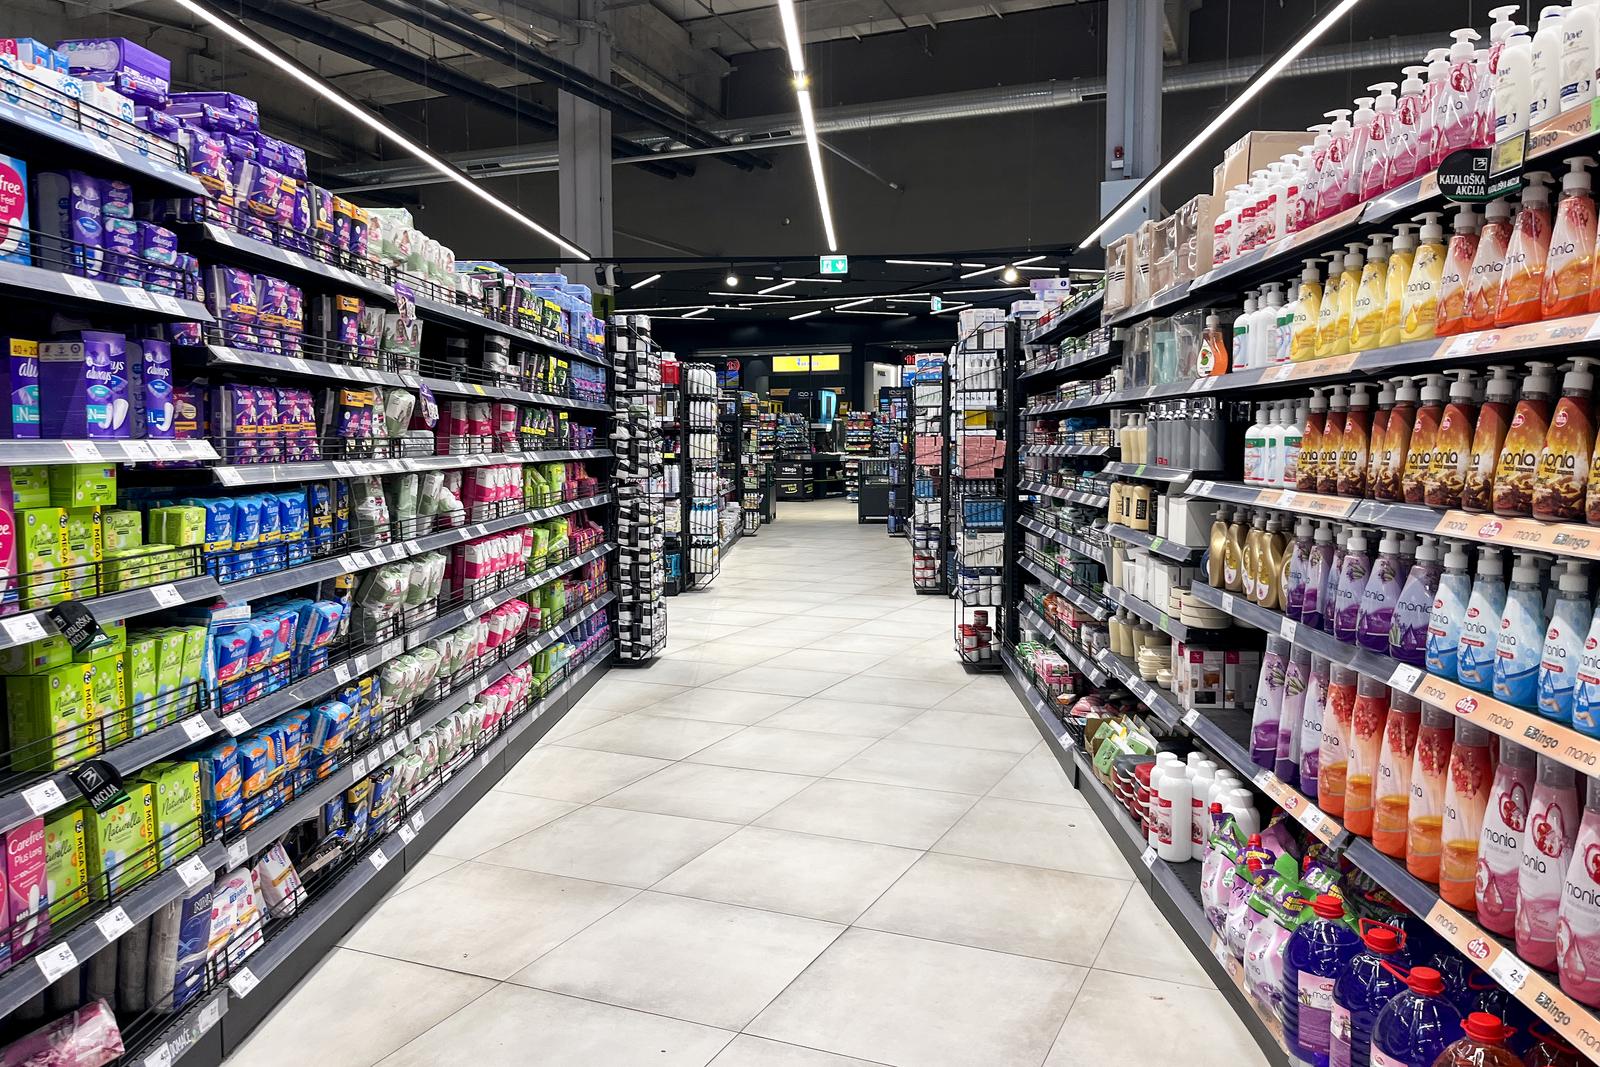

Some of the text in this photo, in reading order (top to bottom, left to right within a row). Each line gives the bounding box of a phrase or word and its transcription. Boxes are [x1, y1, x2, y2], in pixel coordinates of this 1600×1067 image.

[1439, 173, 1486, 185] KATALOŠKA
[1455, 185, 1485, 195] AKCIJA
[86, 366, 112, 384] always
[146, 363, 169, 379] always
[61, 532, 70, 564] MEGA
[94, 528, 102, 558] MEGA
[64, 614, 93, 638] KATALOŠKA
[69, 629, 90, 648] AKCIJA
[85, 689, 94, 720] MEGA
[1423, 684, 1446, 701] monia
[1487, 712, 1514, 730] monia
[1532, 728, 1559, 749] Bingo
[1564, 744, 1597, 766] monia
[90, 784, 119, 808] AKCIJA
[103, 811, 142, 842] Naturella
[145, 809, 153, 837] MEGA
[8, 829, 45, 855] Carefree
[1485, 827, 1517, 849] monia
[14, 846, 43, 867] Plus Long
[77, 837, 85, 866] MEGA
[1435, 913, 1458, 935] monia
[1543, 997, 1571, 1025] Bingo
